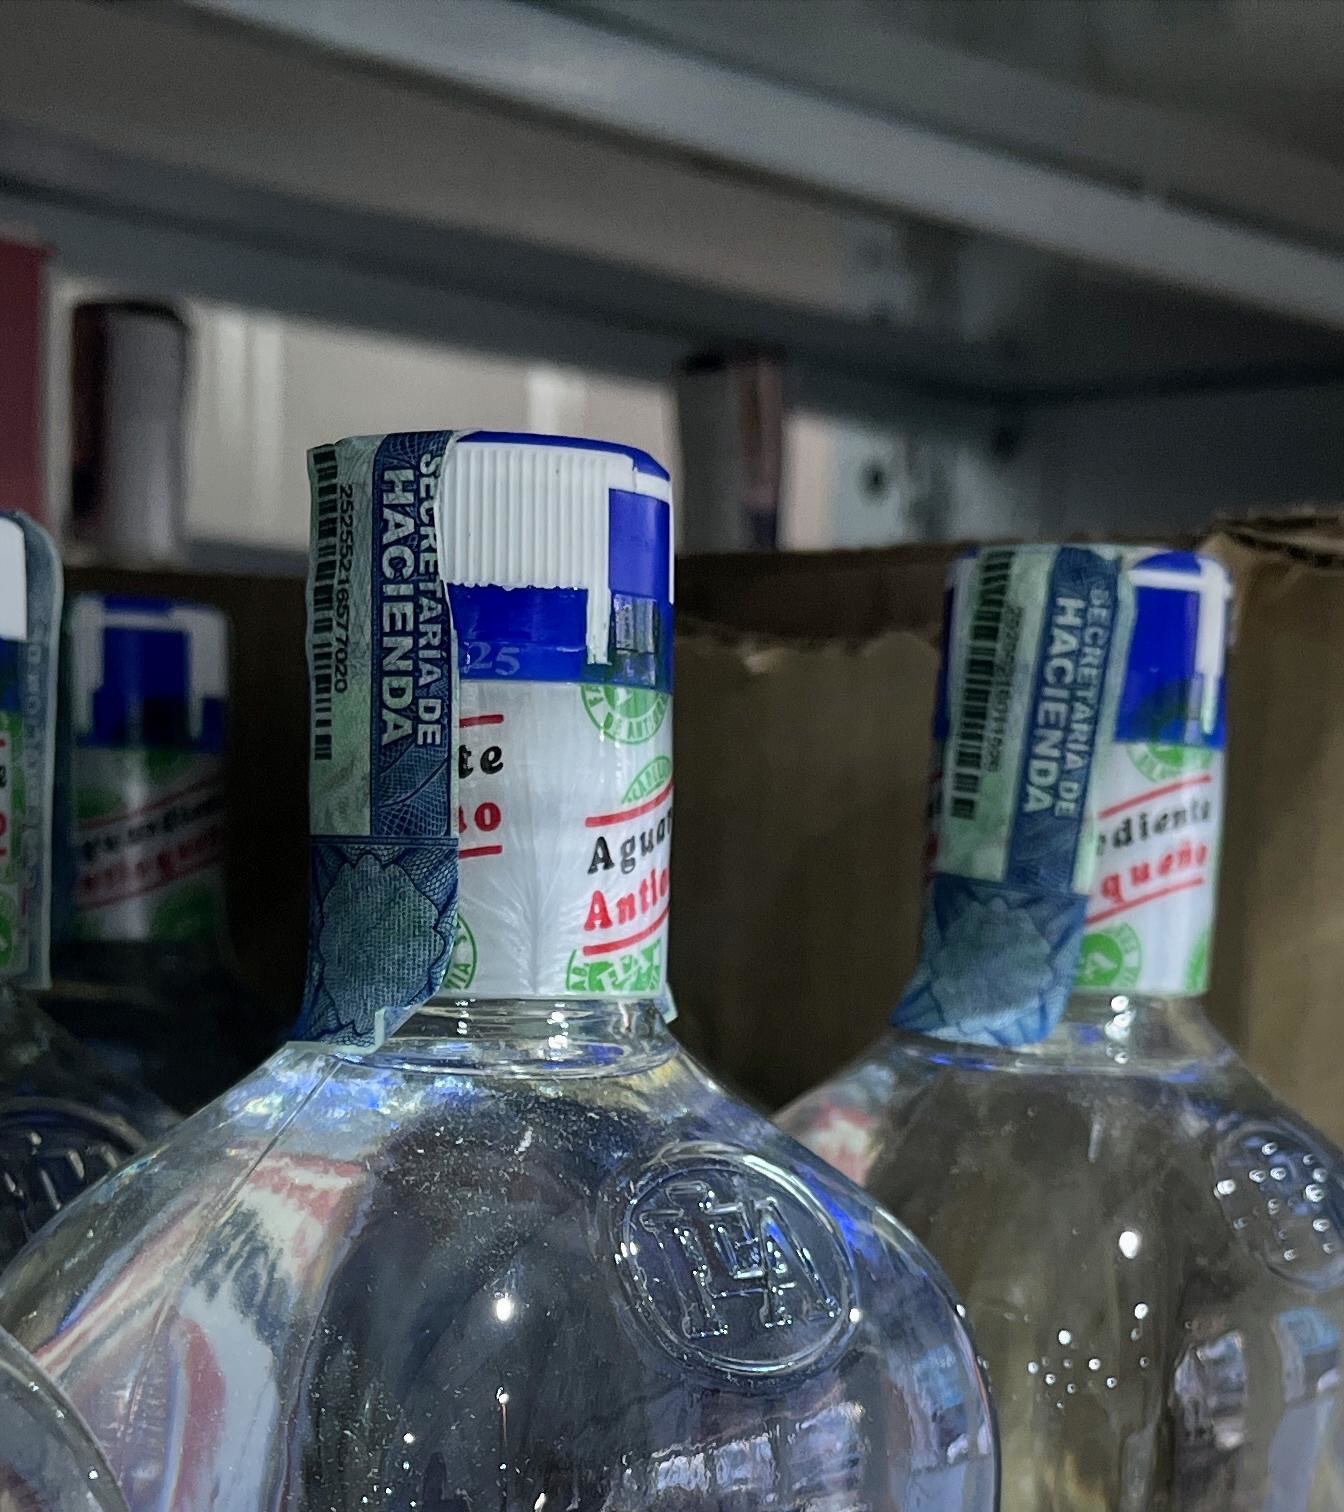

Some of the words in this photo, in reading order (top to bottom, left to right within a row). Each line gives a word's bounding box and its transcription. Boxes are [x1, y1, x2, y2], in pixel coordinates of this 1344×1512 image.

[379, 468, 416, 747] HACIENDA
[416, 696, 443, 747] DE
[1022, 595, 1087, 814] HACIENDA
[458, 744, 504, 779] te
[1052, 778, 1081, 818] DE
